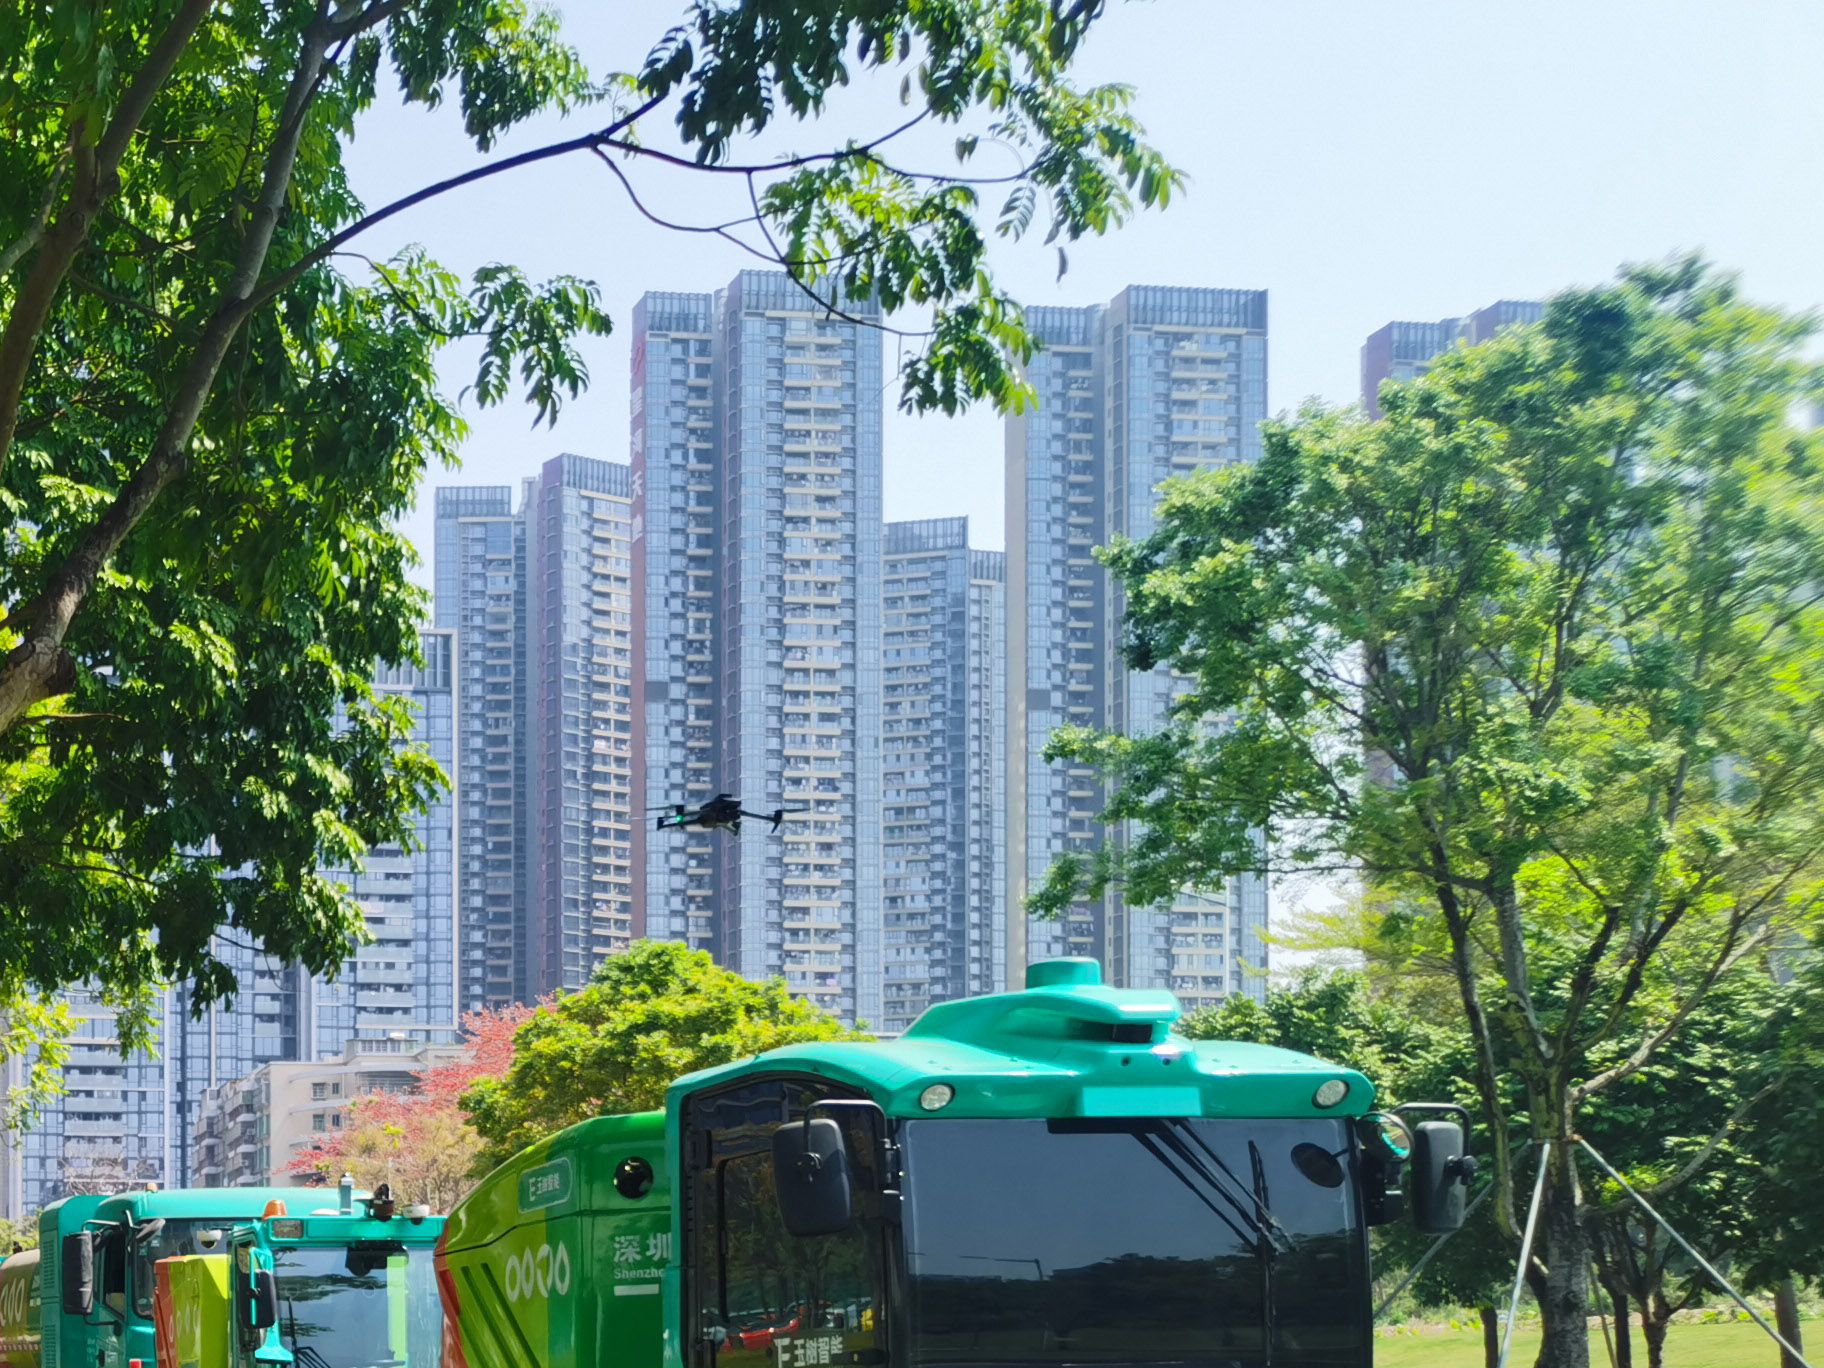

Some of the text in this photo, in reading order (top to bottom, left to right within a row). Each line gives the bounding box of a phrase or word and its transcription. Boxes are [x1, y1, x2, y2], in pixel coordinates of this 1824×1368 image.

[614, 1232, 672, 1262] 深圳
[793, 1334, 844, 1368] 玉树智能
